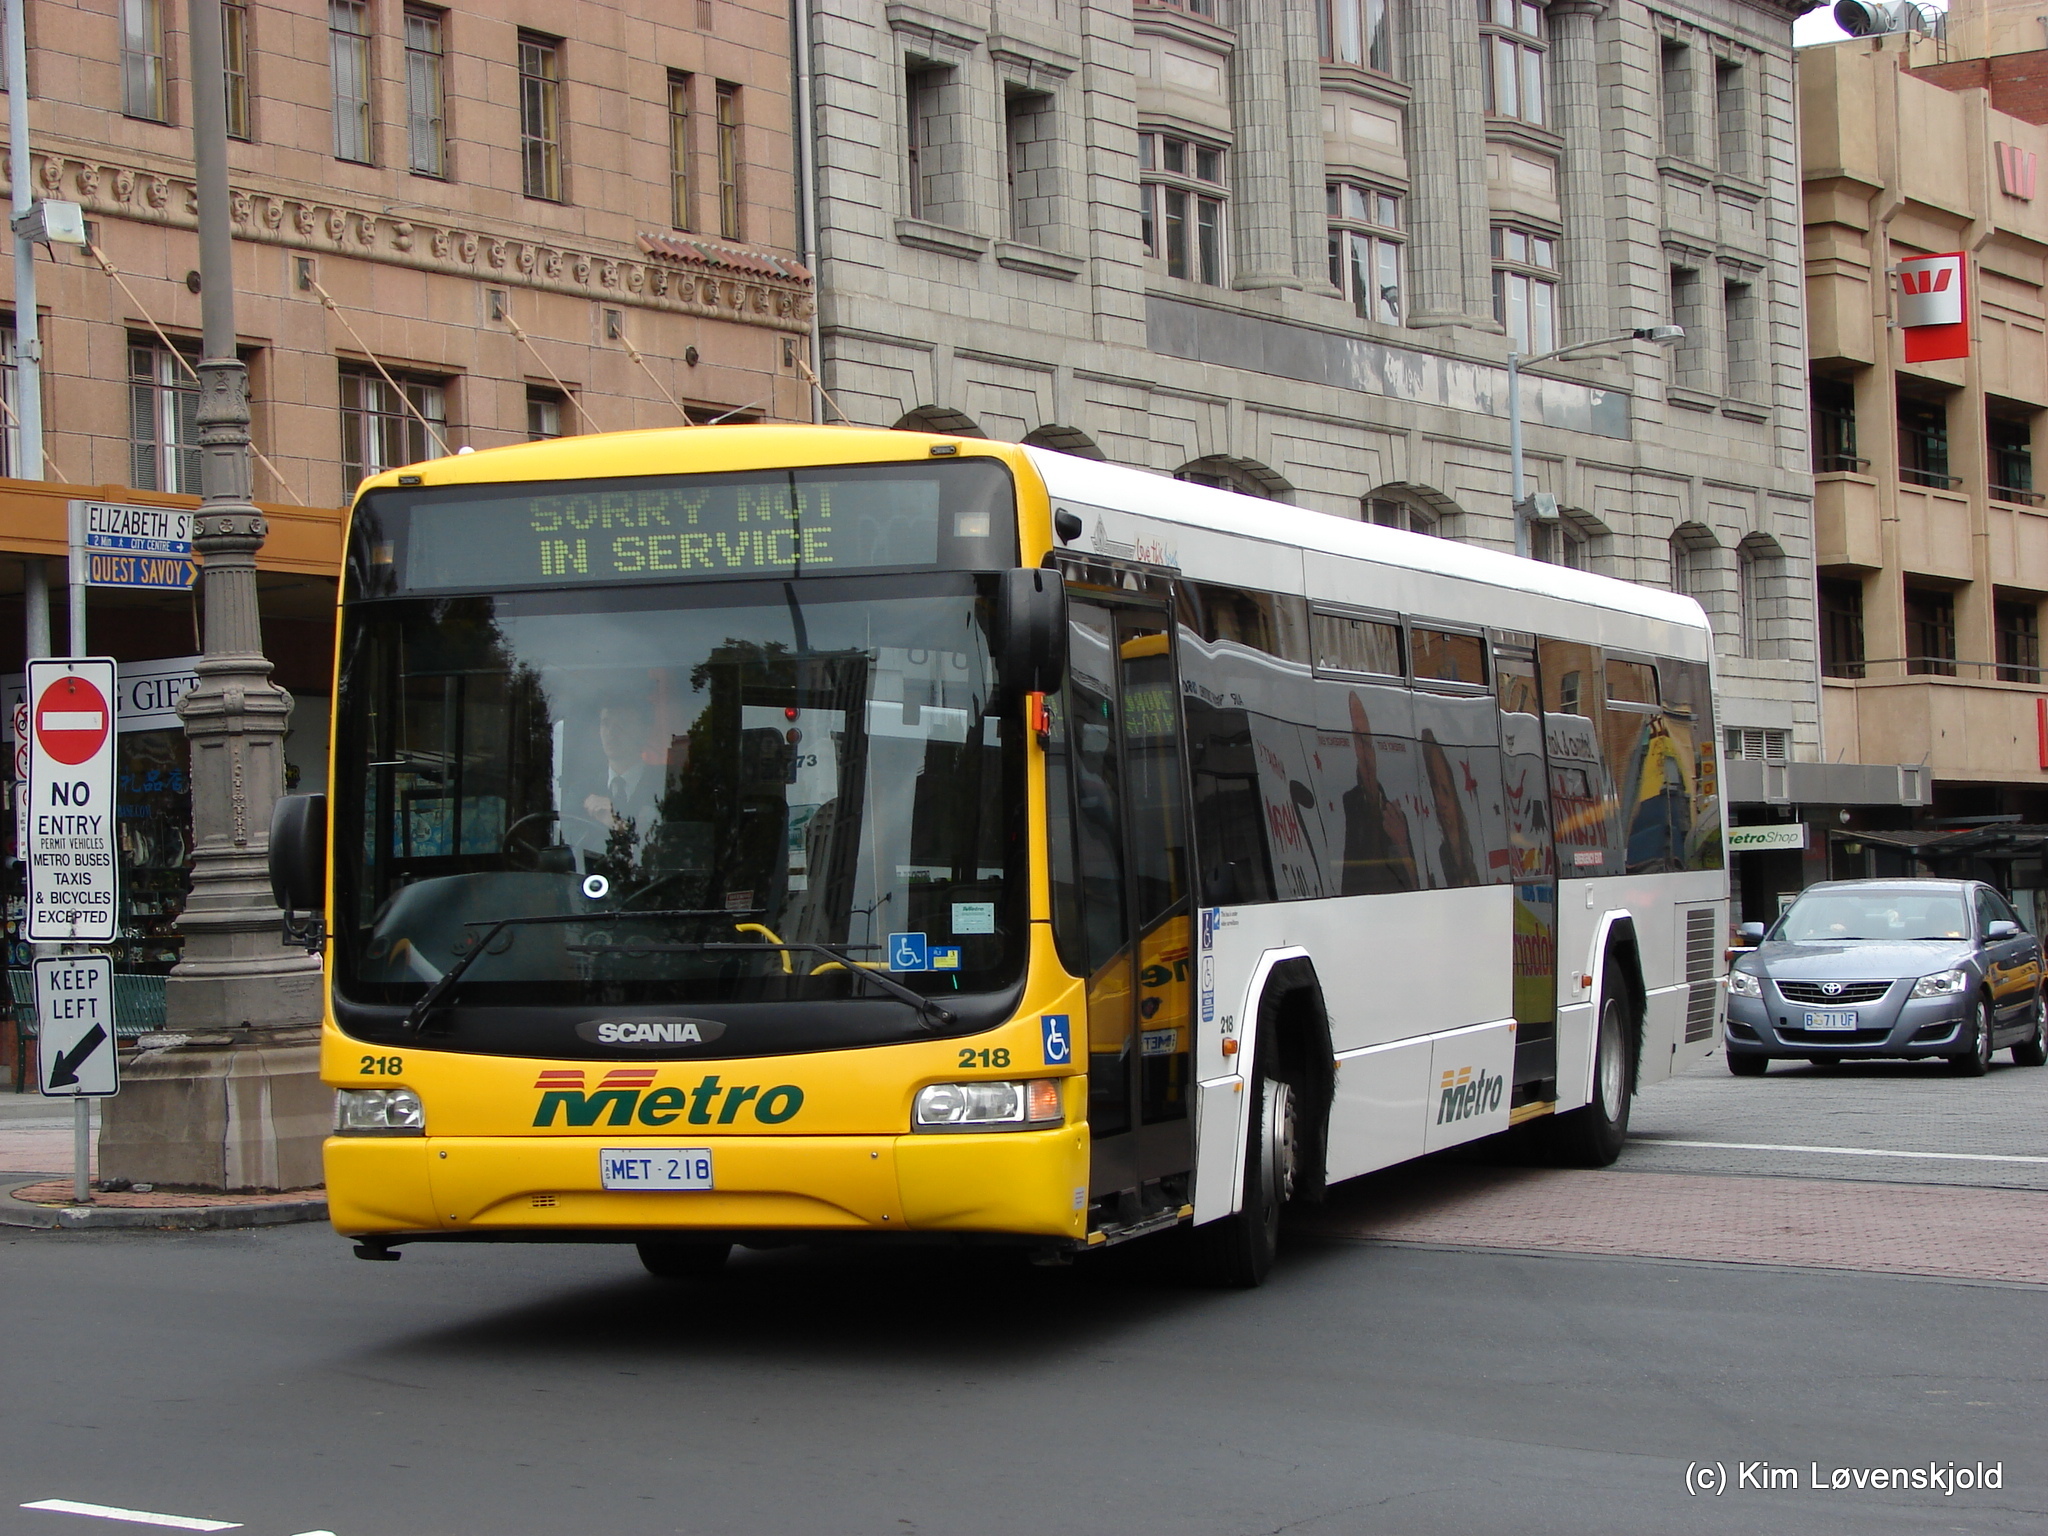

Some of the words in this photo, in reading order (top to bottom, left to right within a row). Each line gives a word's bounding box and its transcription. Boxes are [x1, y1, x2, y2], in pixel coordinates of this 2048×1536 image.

[530, 490, 710, 531] SORRY
[737, 483, 837, 522] NOT
[90, 507, 168, 537] ELIZABETH
[94, 535, 99, 546] 2
[101, 536, 112, 548] Min
[130, 537, 145, 549] CITY
[147, 540, 171, 552] CENTRE
[541, 538, 588, 575] IN
[612, 527, 833, 571] SERVICE
[92, 556, 136, 583] QUEST
[141, 558, 183, 585] SAVOY
[51, 781, 90, 807] NO
[38, 815, 102, 836] ENTRY
[40, 838, 66, 849] PERMIT
[69, 838, 104, 849] VEHICLES
[33, 853, 71, 867] METRO
[75, 853, 110, 867] BUSES
[53, 872, 92, 885] TAXIS
[35, 891, 44, 905] &
[50, 891, 111, 905] BICYCLES
[38, 910, 107, 923] EXCEPTED
[50, 969, 99, 990] KEEP
[53, 998, 98, 1019] LEFT
[597, 1023, 702, 1043] SCANIA
[1220, 1016, 1234, 1034] 218
[360, 1055, 403, 1076] 218
[958, 1048, 1011, 1068] 218
[532, 1069, 805, 1127] Metro
[1436, 1066, 1504, 1126] Metro
[611, 1159, 652, 1180] MET
[667, 1159, 710, 1180] 218
